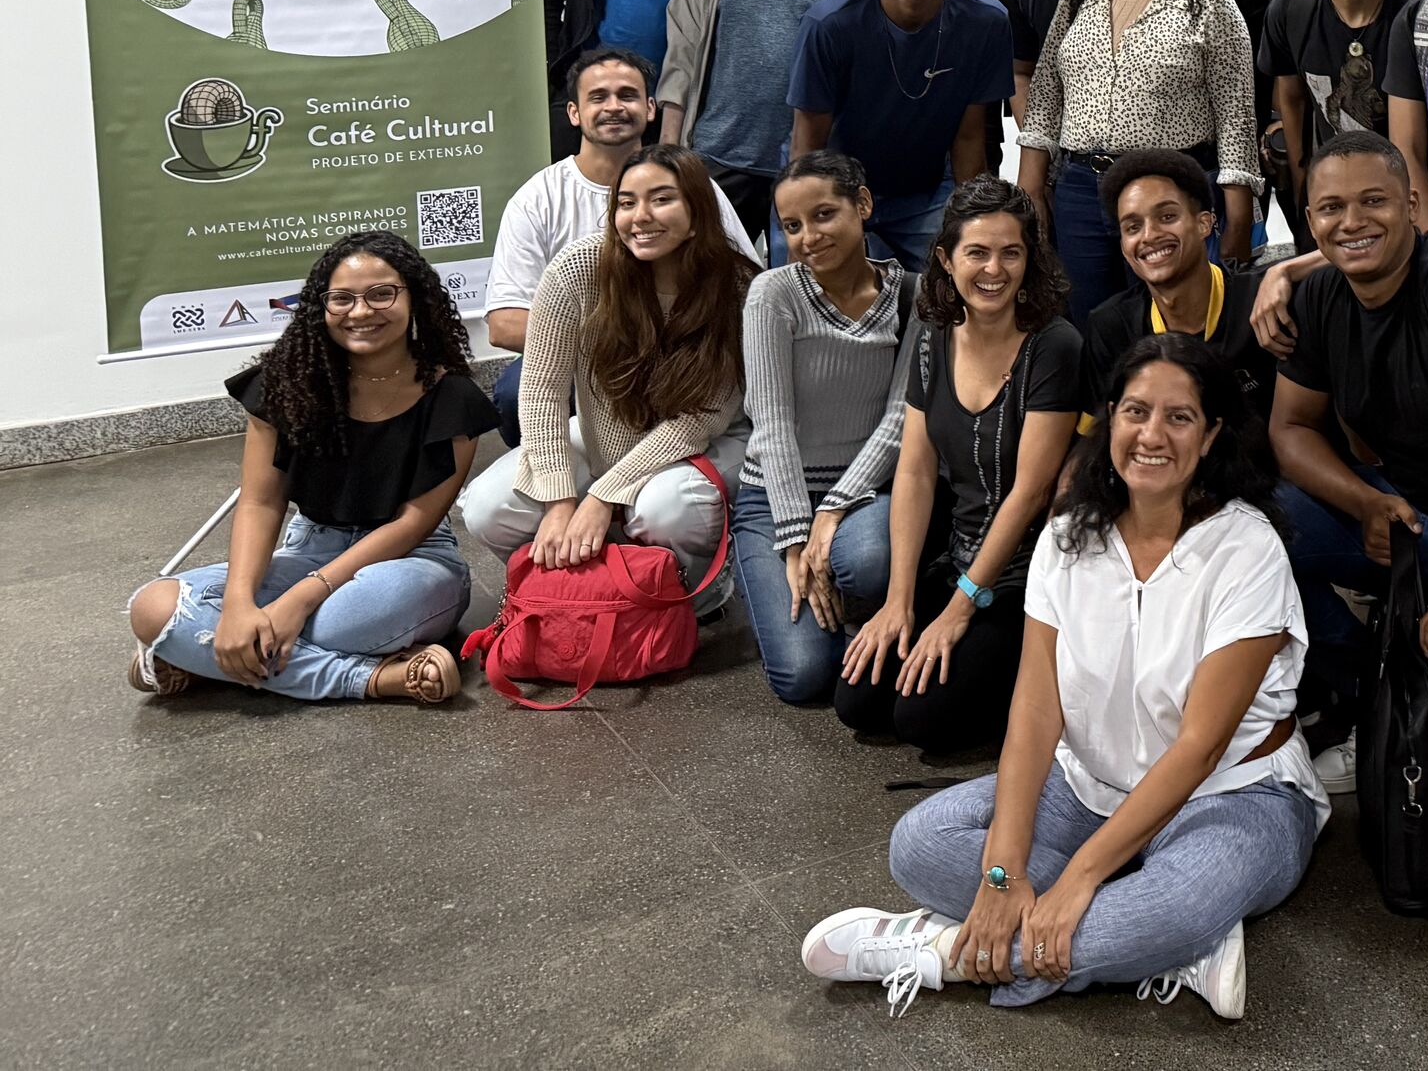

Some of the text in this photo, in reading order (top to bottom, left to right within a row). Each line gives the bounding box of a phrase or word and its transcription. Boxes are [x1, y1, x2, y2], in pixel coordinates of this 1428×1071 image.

[306, 94, 411, 115] Seminário
[307, 110, 494, 147] Café Cultural
[312, 144, 484, 169] PROJETO DE EXTENSÃO
[187, 206, 407, 237] A MATEMÁTICA INSPIRANDO
[265, 219, 408, 243] NOVAS CONEXÕES
[217, 242, 332, 261] www.cafeculturaldm
